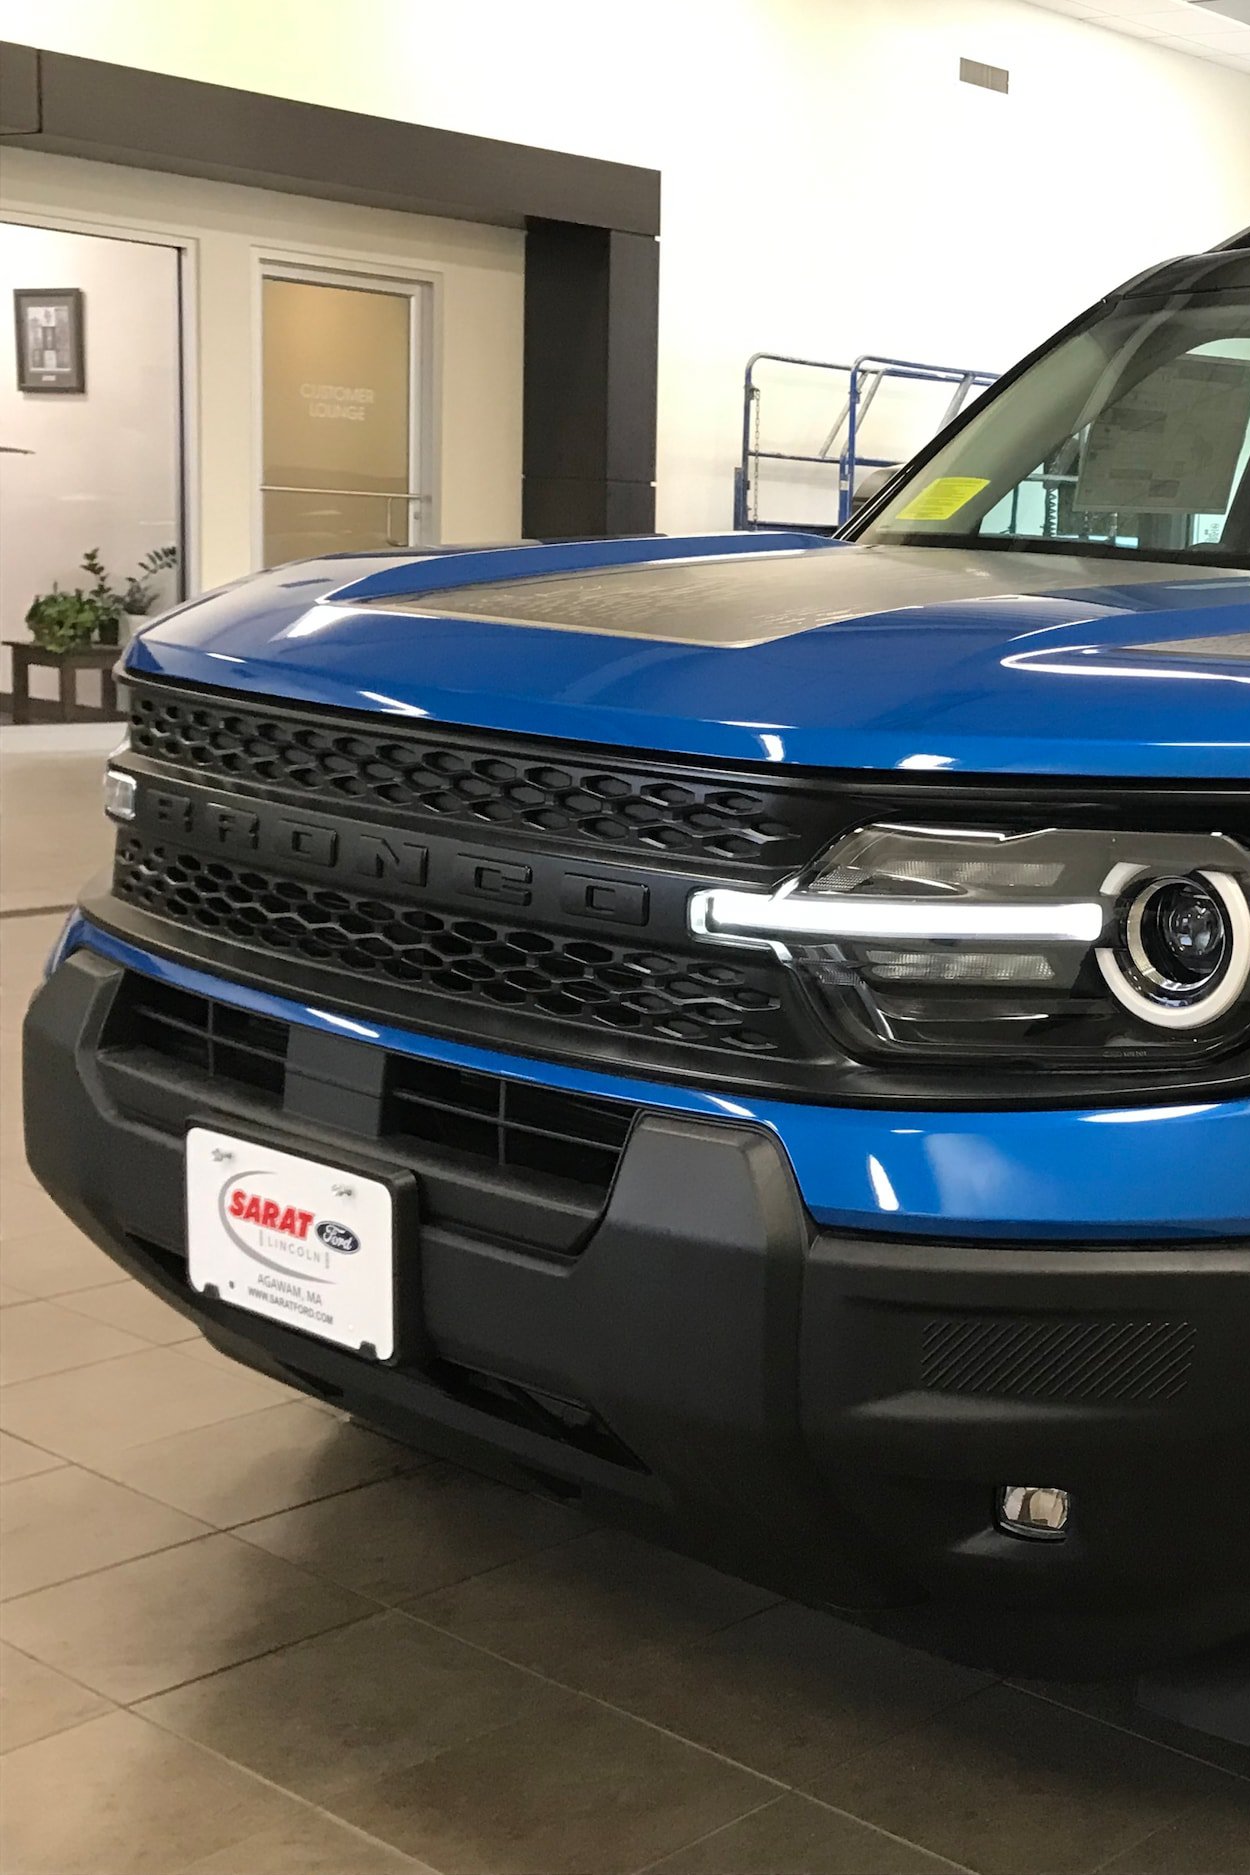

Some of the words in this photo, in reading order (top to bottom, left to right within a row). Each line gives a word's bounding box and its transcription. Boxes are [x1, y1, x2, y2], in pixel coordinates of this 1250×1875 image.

[300, 383, 374, 403] CUSTOMER
[309, 402, 365, 420] LOUNGE
[145, 788, 650, 926] BRONCO
[229, 1189, 315, 1240] SARAT
[268, 1236, 320, 1263] LINCOLN
[320, 1223, 356, 1252] Ford
[247, 1286, 333, 1325] WWW.SARATFORD.COM
[306, 1290, 322, 1306] MA
